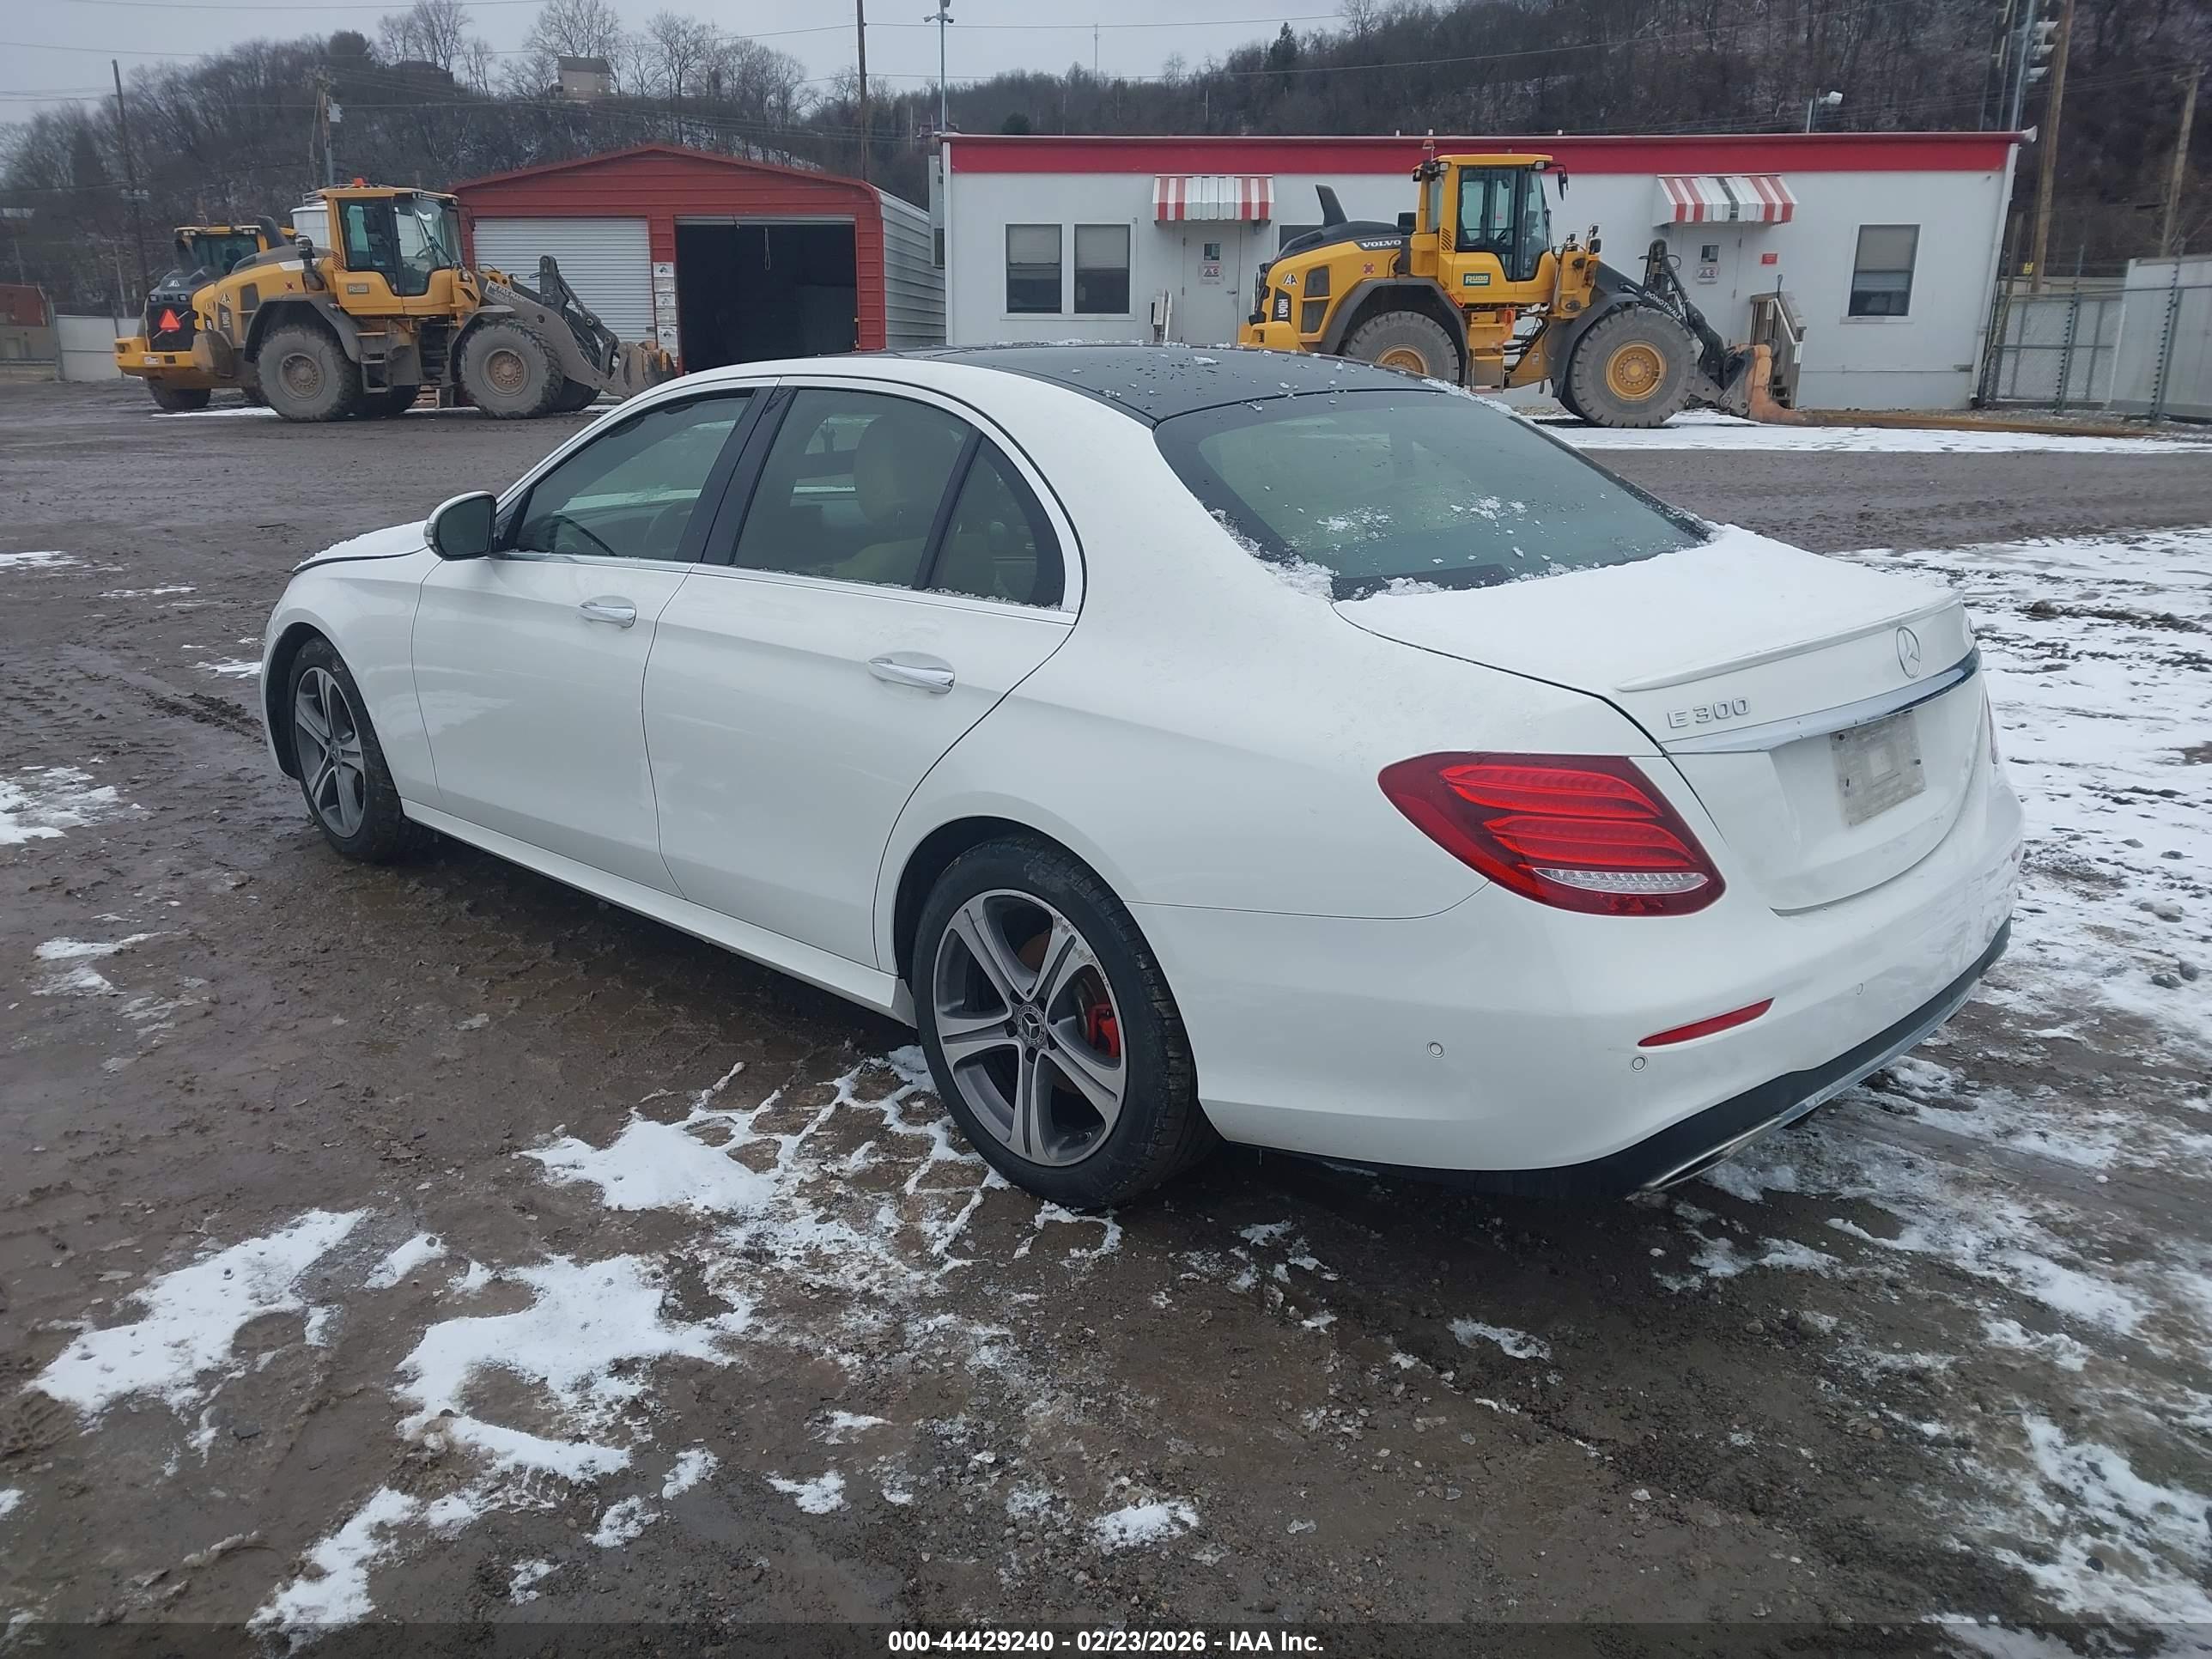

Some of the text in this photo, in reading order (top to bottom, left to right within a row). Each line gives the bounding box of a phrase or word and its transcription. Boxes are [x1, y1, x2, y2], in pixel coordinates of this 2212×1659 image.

[1361, 240, 1402, 248] VOLVO
[1464, 275, 1489, 284] RUDD
[1278, 298, 1289, 318] L90H
[1667, 697, 1750, 728] E 300
